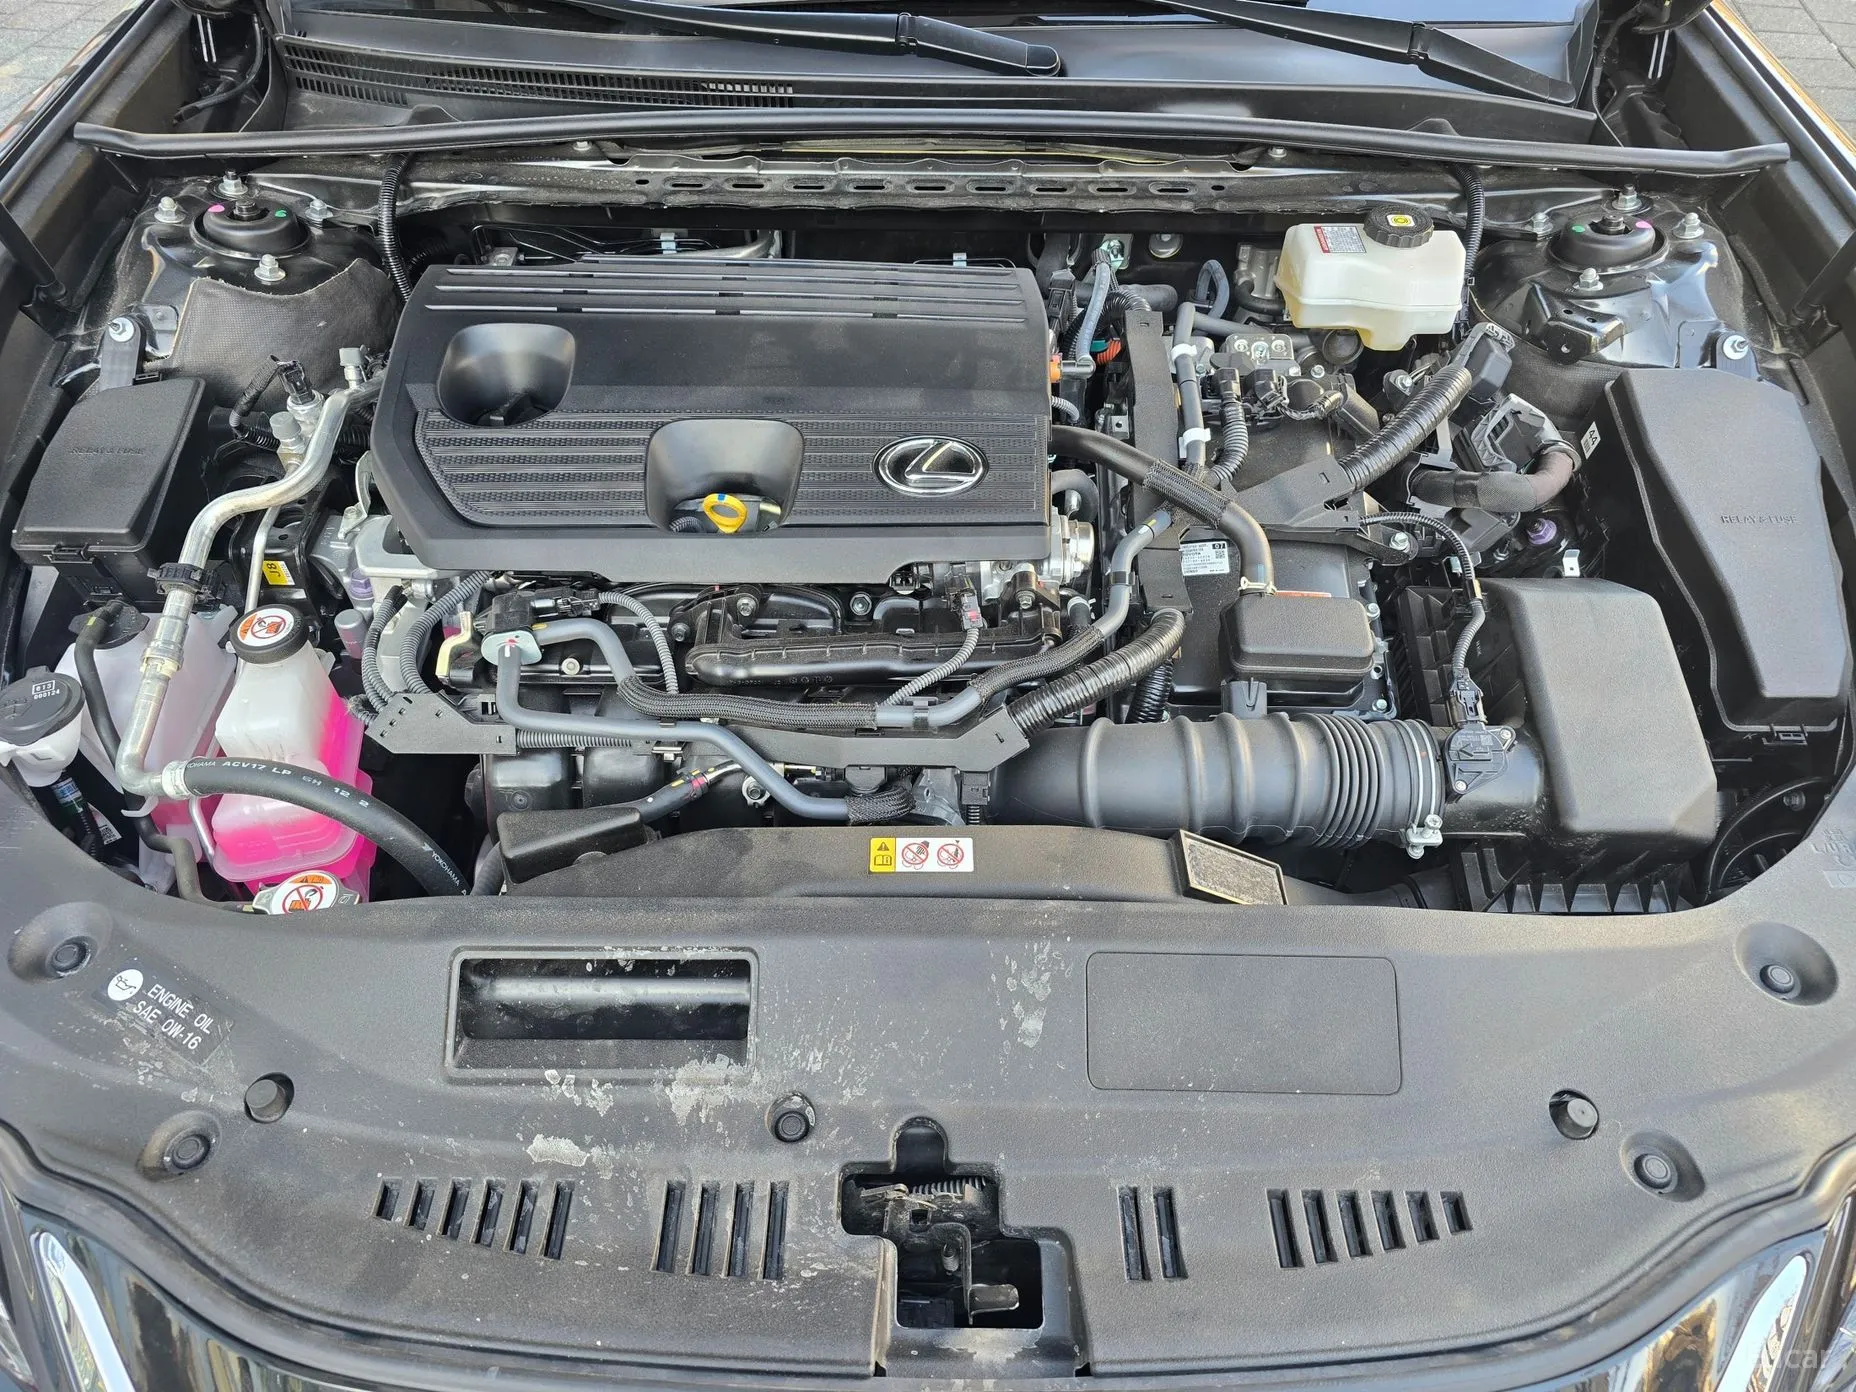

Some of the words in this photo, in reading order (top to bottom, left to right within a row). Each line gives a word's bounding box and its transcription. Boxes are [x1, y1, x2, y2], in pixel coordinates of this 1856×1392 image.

[1720, 514, 1756, 524] RELAY
[1768, 514, 1797, 525] FUSE
[221, 761, 267, 770] ACV17
[272, 767, 292, 775] LP
[333, 787, 350, 798] 12
[431, 850, 460, 887] YOKOHAMA
[133, 1000, 162, 1023] SAE
[147, 983, 194, 1019] ENGINE
[194, 1013, 214, 1034] OIL
